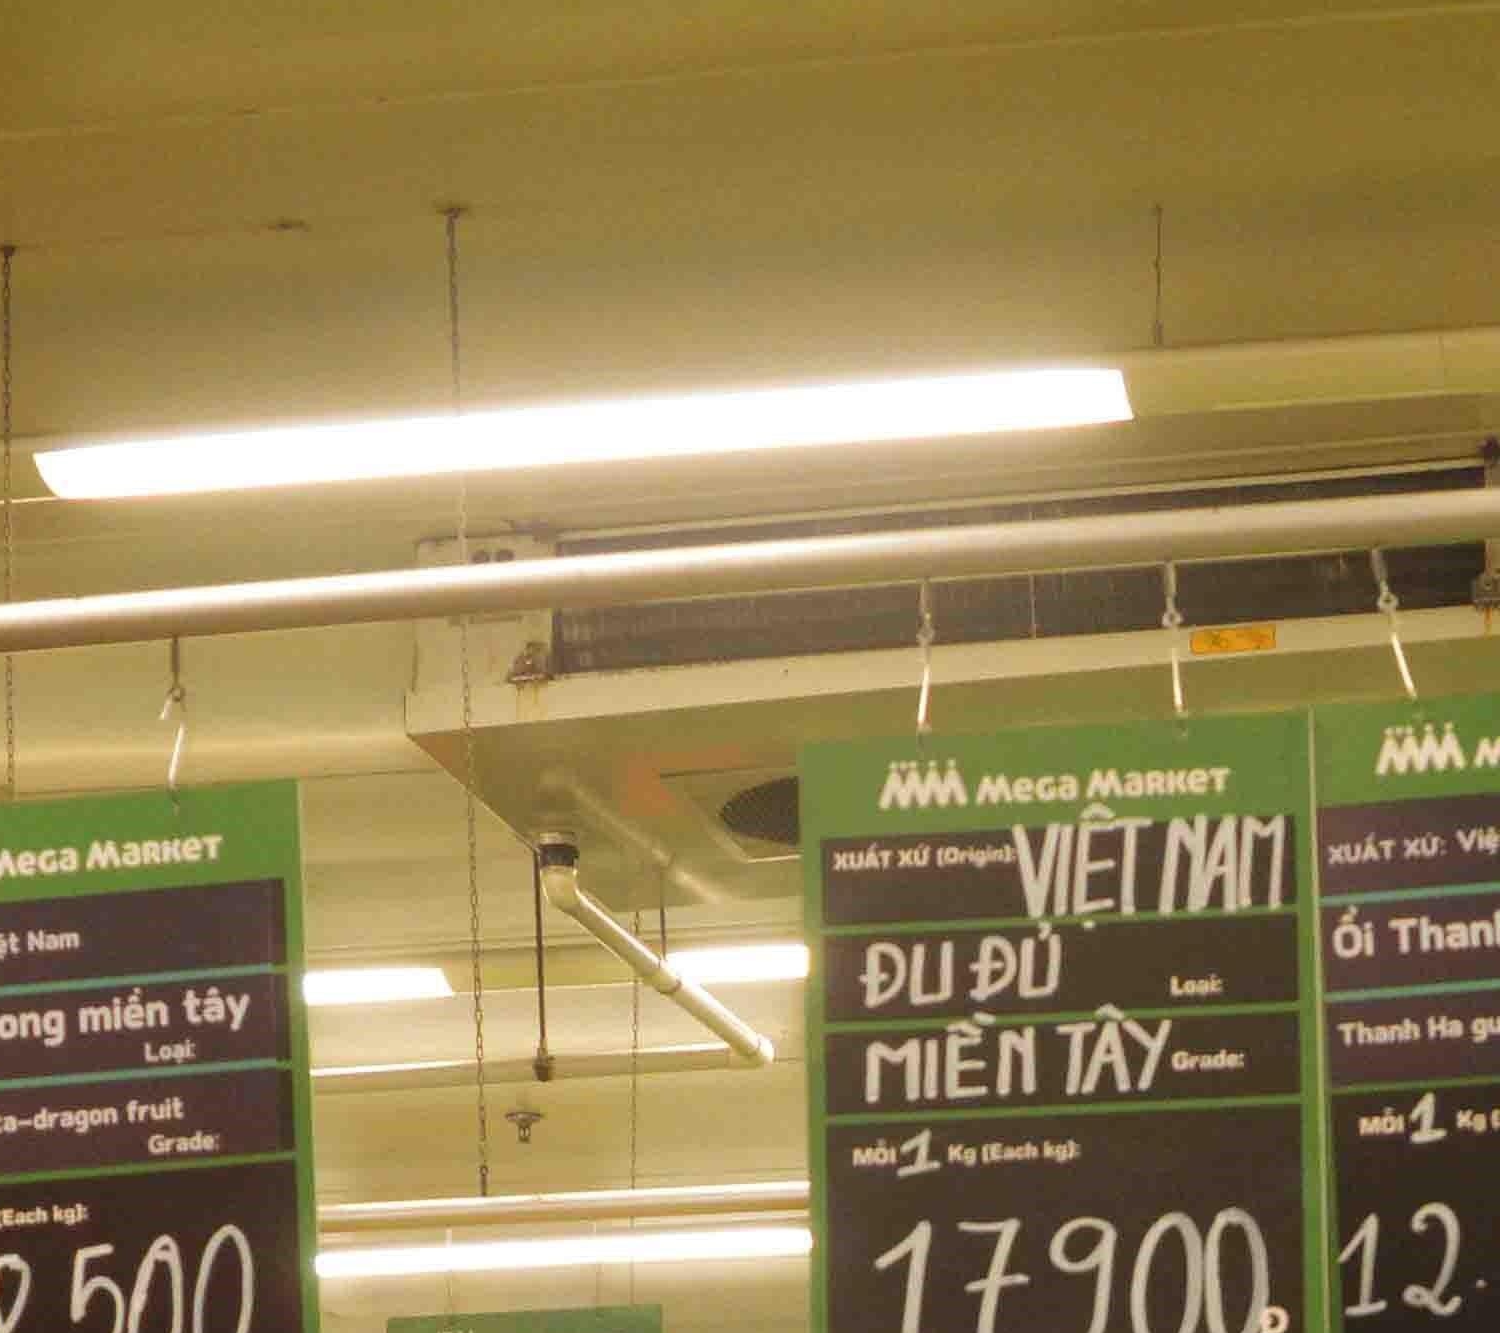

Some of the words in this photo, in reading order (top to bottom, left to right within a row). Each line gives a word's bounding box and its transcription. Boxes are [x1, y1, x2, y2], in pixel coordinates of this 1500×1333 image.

[1158, 814, 1285, 916] NAM
[183, 988, 251, 1031] tây
[1337, 1020, 1418, 1045] Thanh
[1427, 1016, 1463, 1039] Ha
[1057, 1004, 1172, 1095] TÂY
[127, 1097, 184, 1125] fruit
